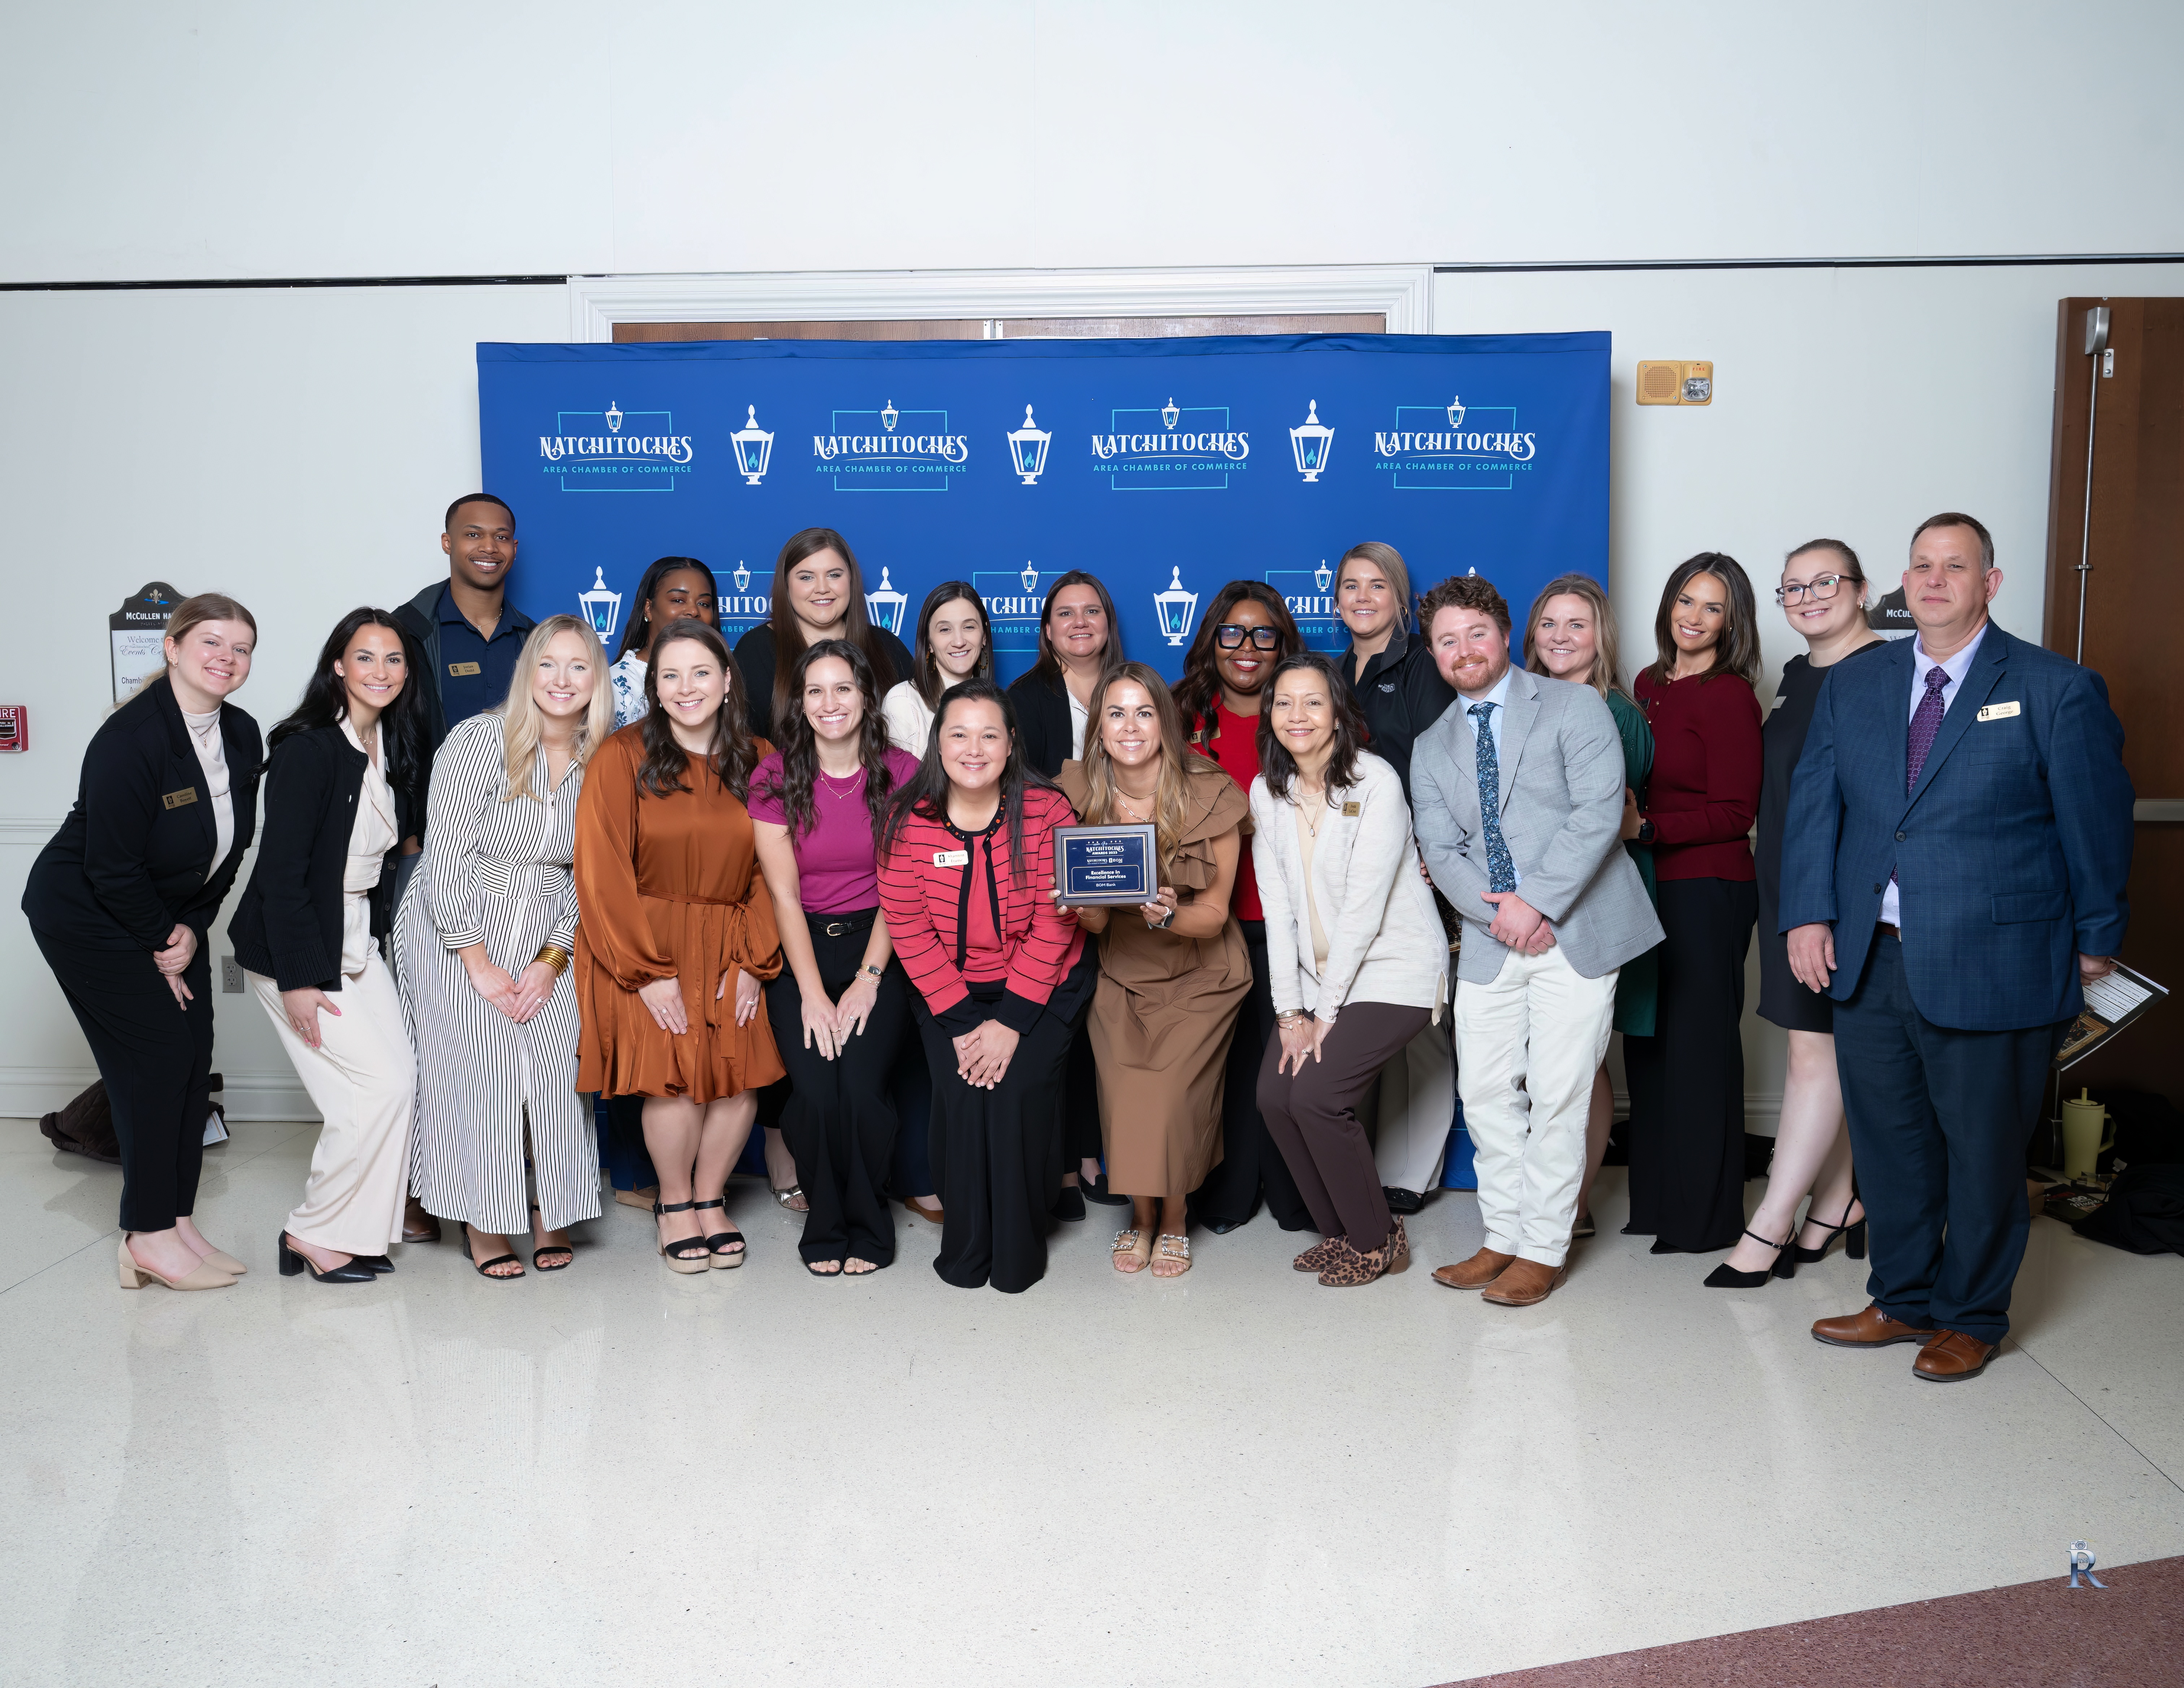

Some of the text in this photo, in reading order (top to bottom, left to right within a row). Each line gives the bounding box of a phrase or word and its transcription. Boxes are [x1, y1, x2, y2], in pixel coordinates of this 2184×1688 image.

[539, 436, 692, 463] NATCHITOCHES
[813, 435, 968, 462] NATCHITOCHES
[1091, 432, 1249, 460] NATCHITOCHES
[1374, 432, 1535, 461] NATCHITOCHES
[1886, 609, 1913, 617] McCUL
